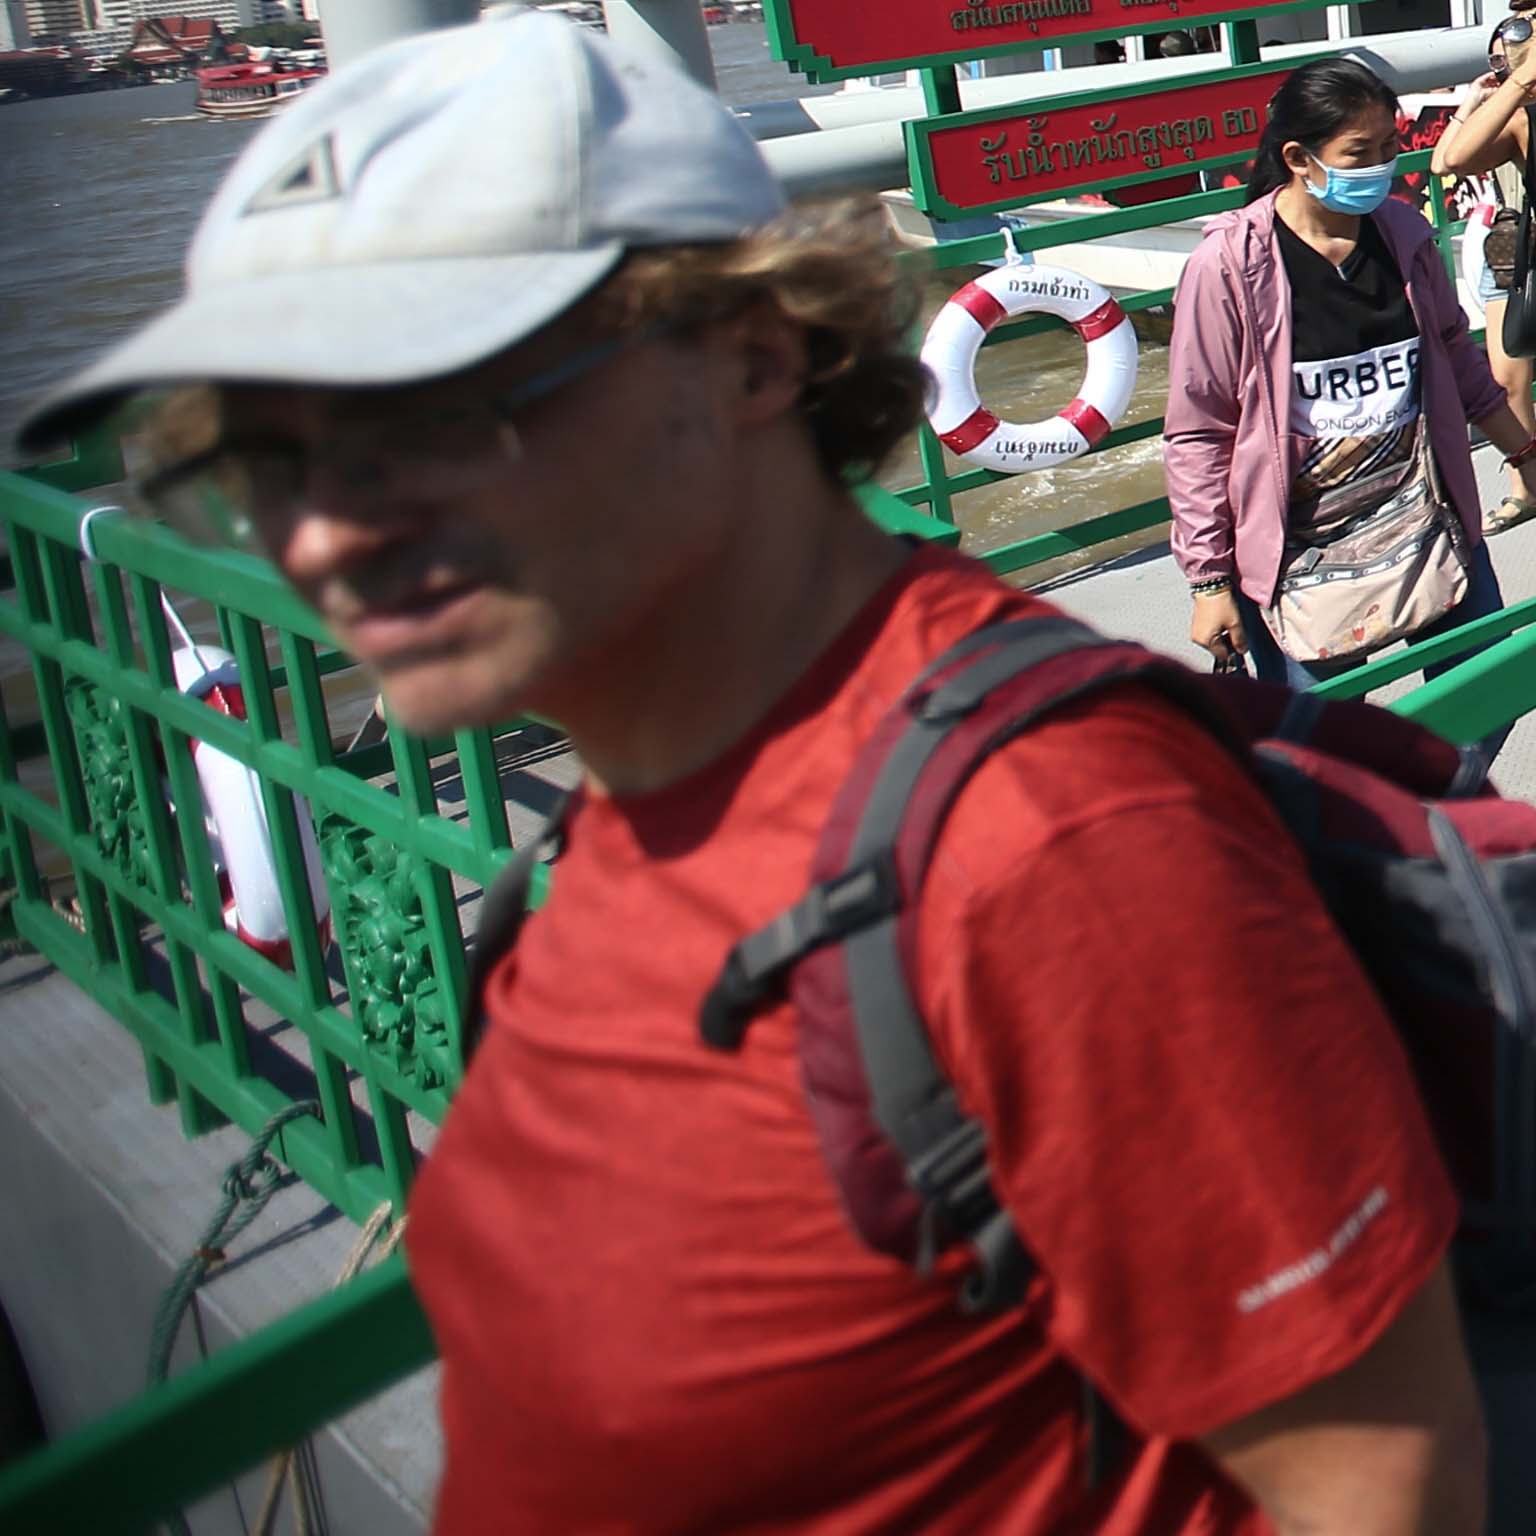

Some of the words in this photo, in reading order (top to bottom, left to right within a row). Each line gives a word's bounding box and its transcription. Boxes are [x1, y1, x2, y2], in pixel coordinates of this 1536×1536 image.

[980, 112, 1213, 184] รับน้ำหนักสูงสุด
[1313, 415, 1381, 432] ONDON
